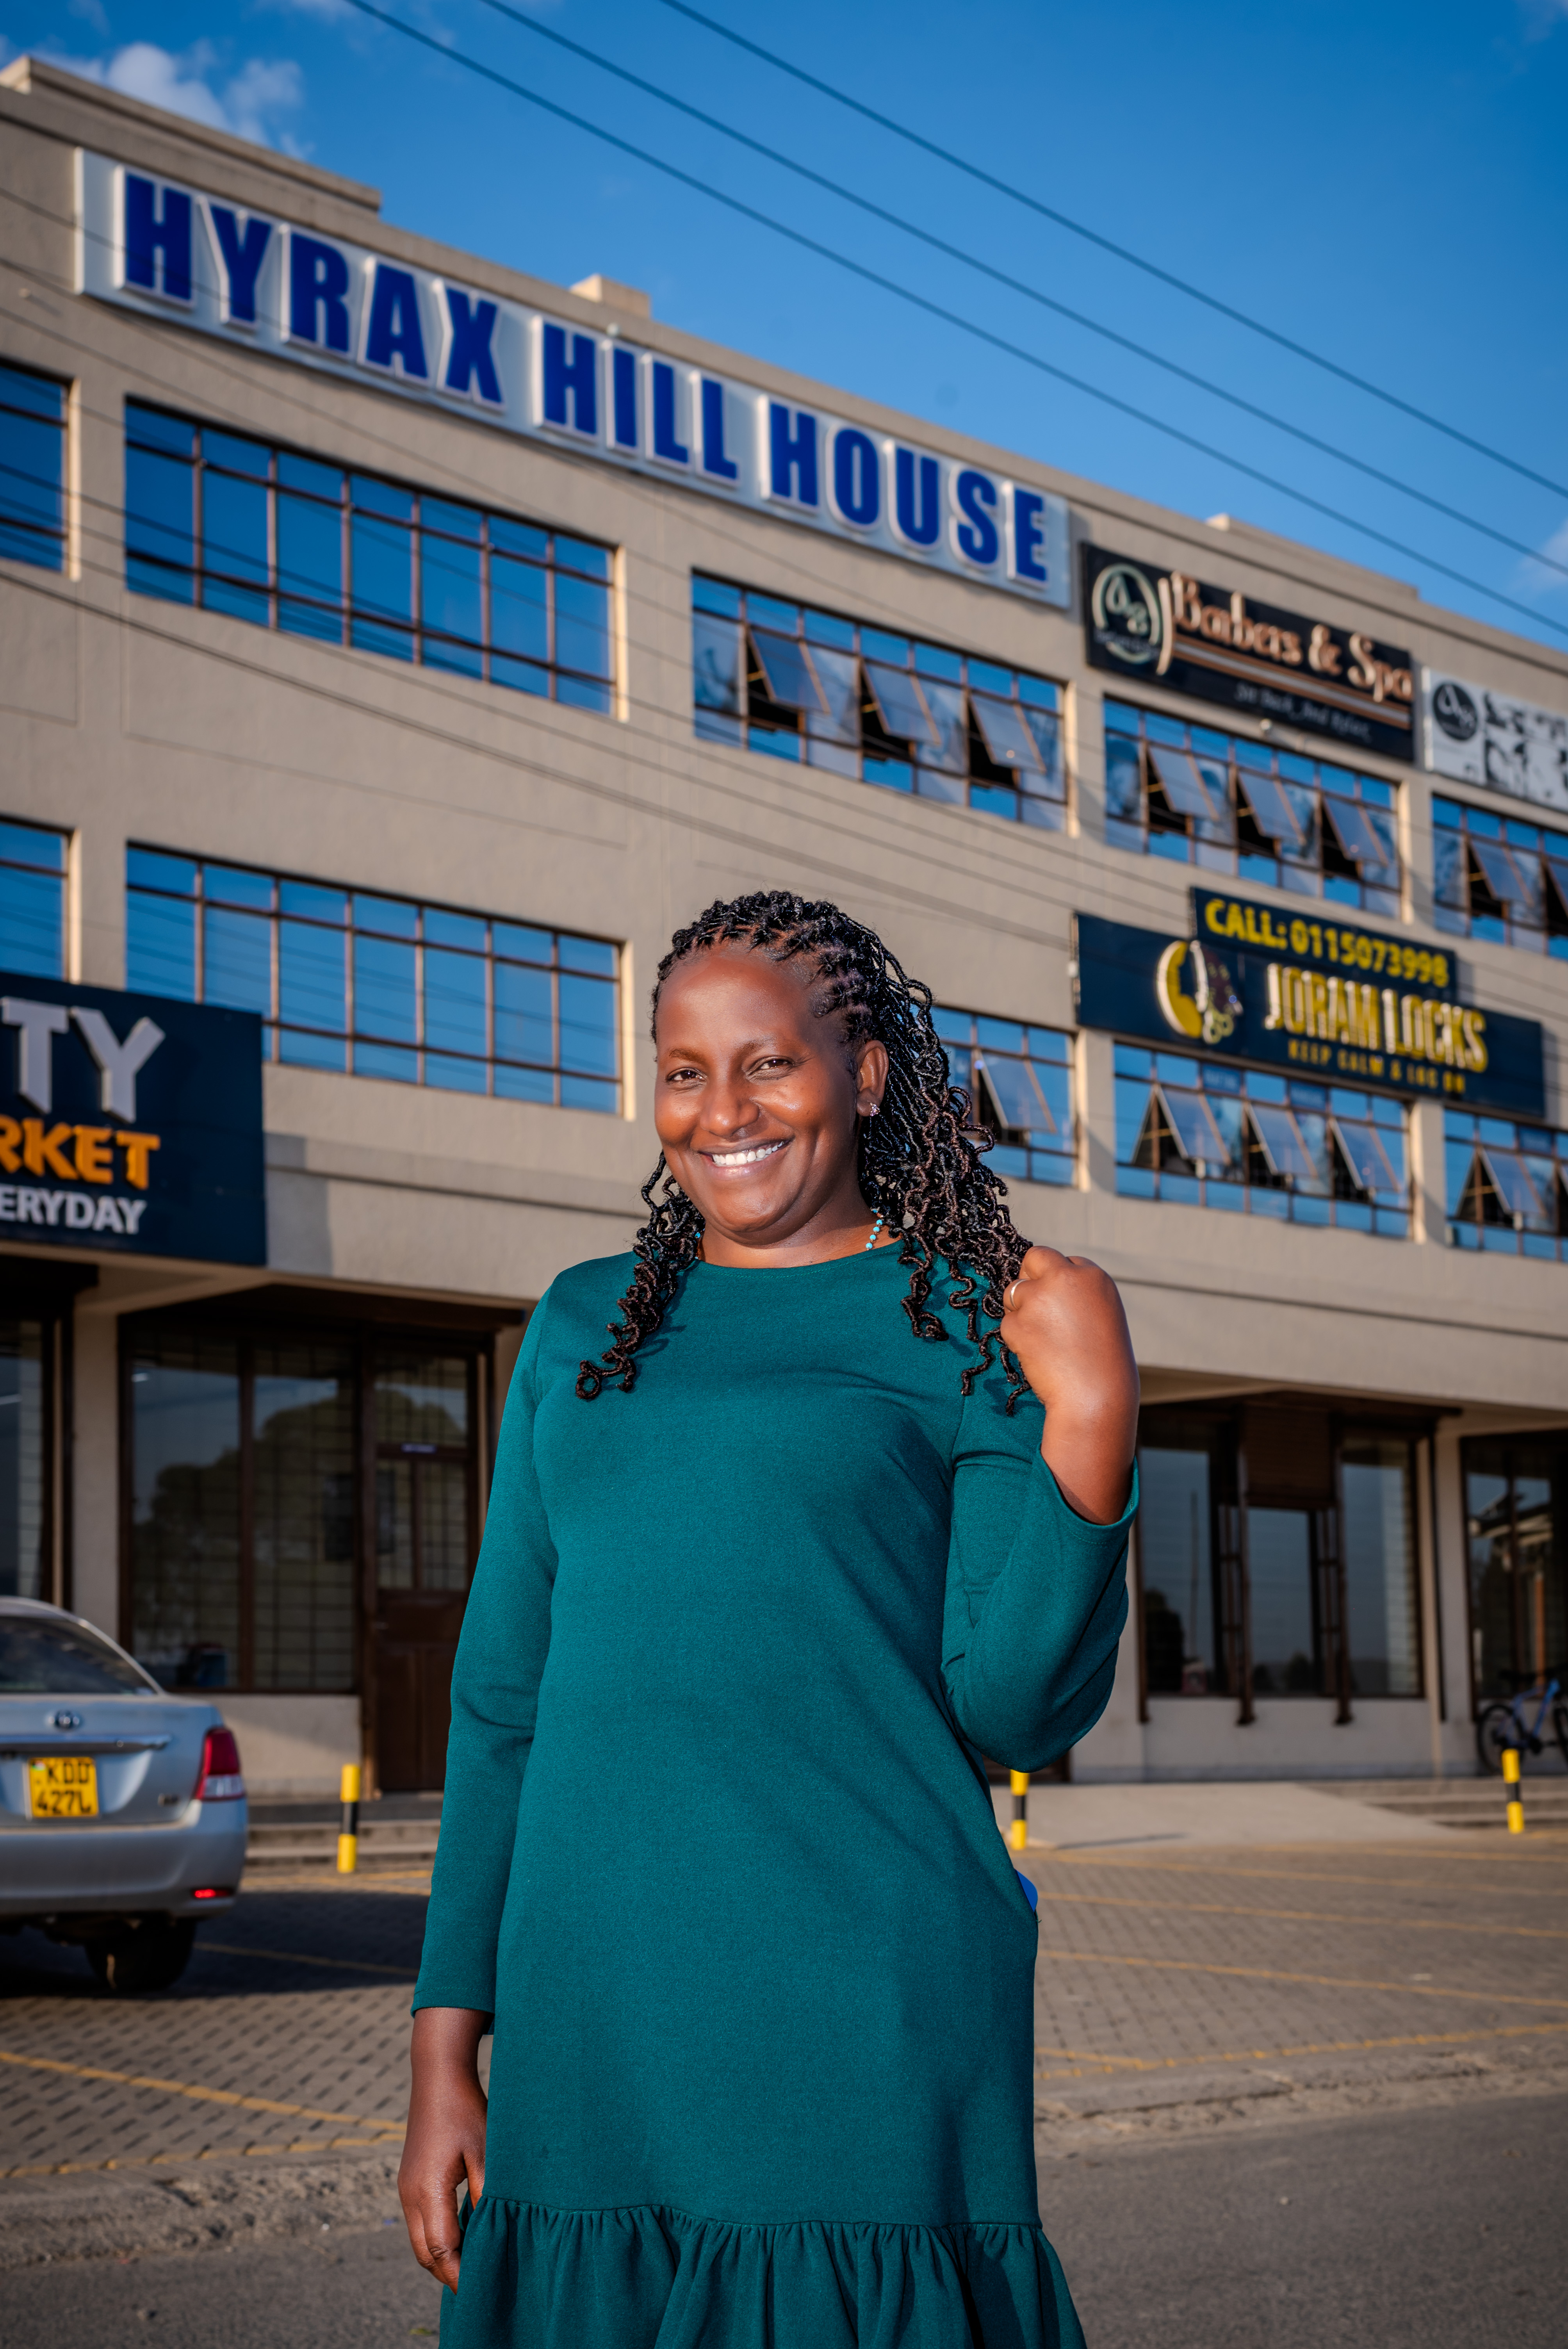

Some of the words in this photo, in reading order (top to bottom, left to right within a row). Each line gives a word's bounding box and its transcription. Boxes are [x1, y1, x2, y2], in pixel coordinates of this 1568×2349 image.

[116, 166, 505, 409] HYRAX
[534, 317, 738, 484] HILL
[759, 396, 1048, 586] HOUSE
[1309, 624, 1342, 676] &
[1347, 632, 1412, 702] Spa
[2, 996, 166, 1123] TY
[1265, 963, 1381, 1051] JORAM
[1382, 988, 1488, 1073] LOCKS
[1289, 1039, 1332, 1066] KEEP
[0, 1183, 147, 1235] ERYDAY
